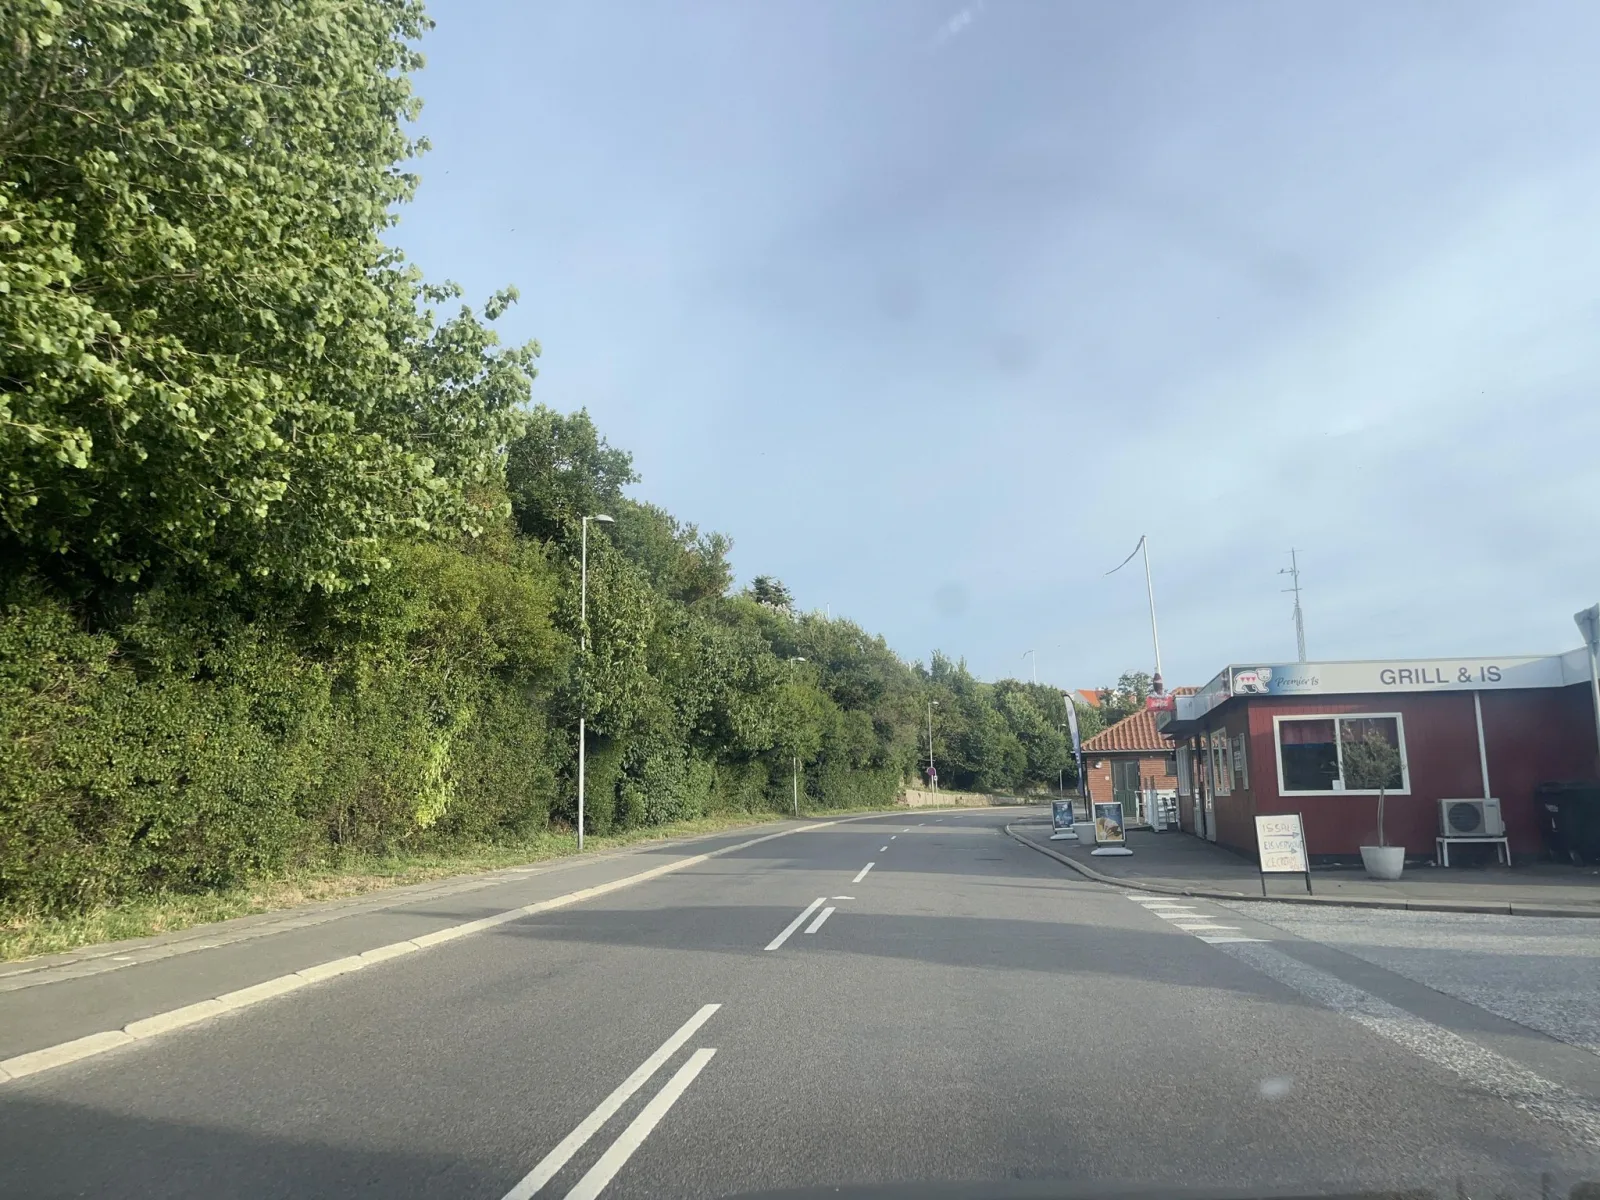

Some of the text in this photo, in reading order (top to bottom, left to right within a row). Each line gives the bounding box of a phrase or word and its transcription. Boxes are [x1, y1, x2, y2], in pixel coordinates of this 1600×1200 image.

[1275, 676, 1309, 688] Premier
[1380, 665, 1502, 685] GRILL & IS
